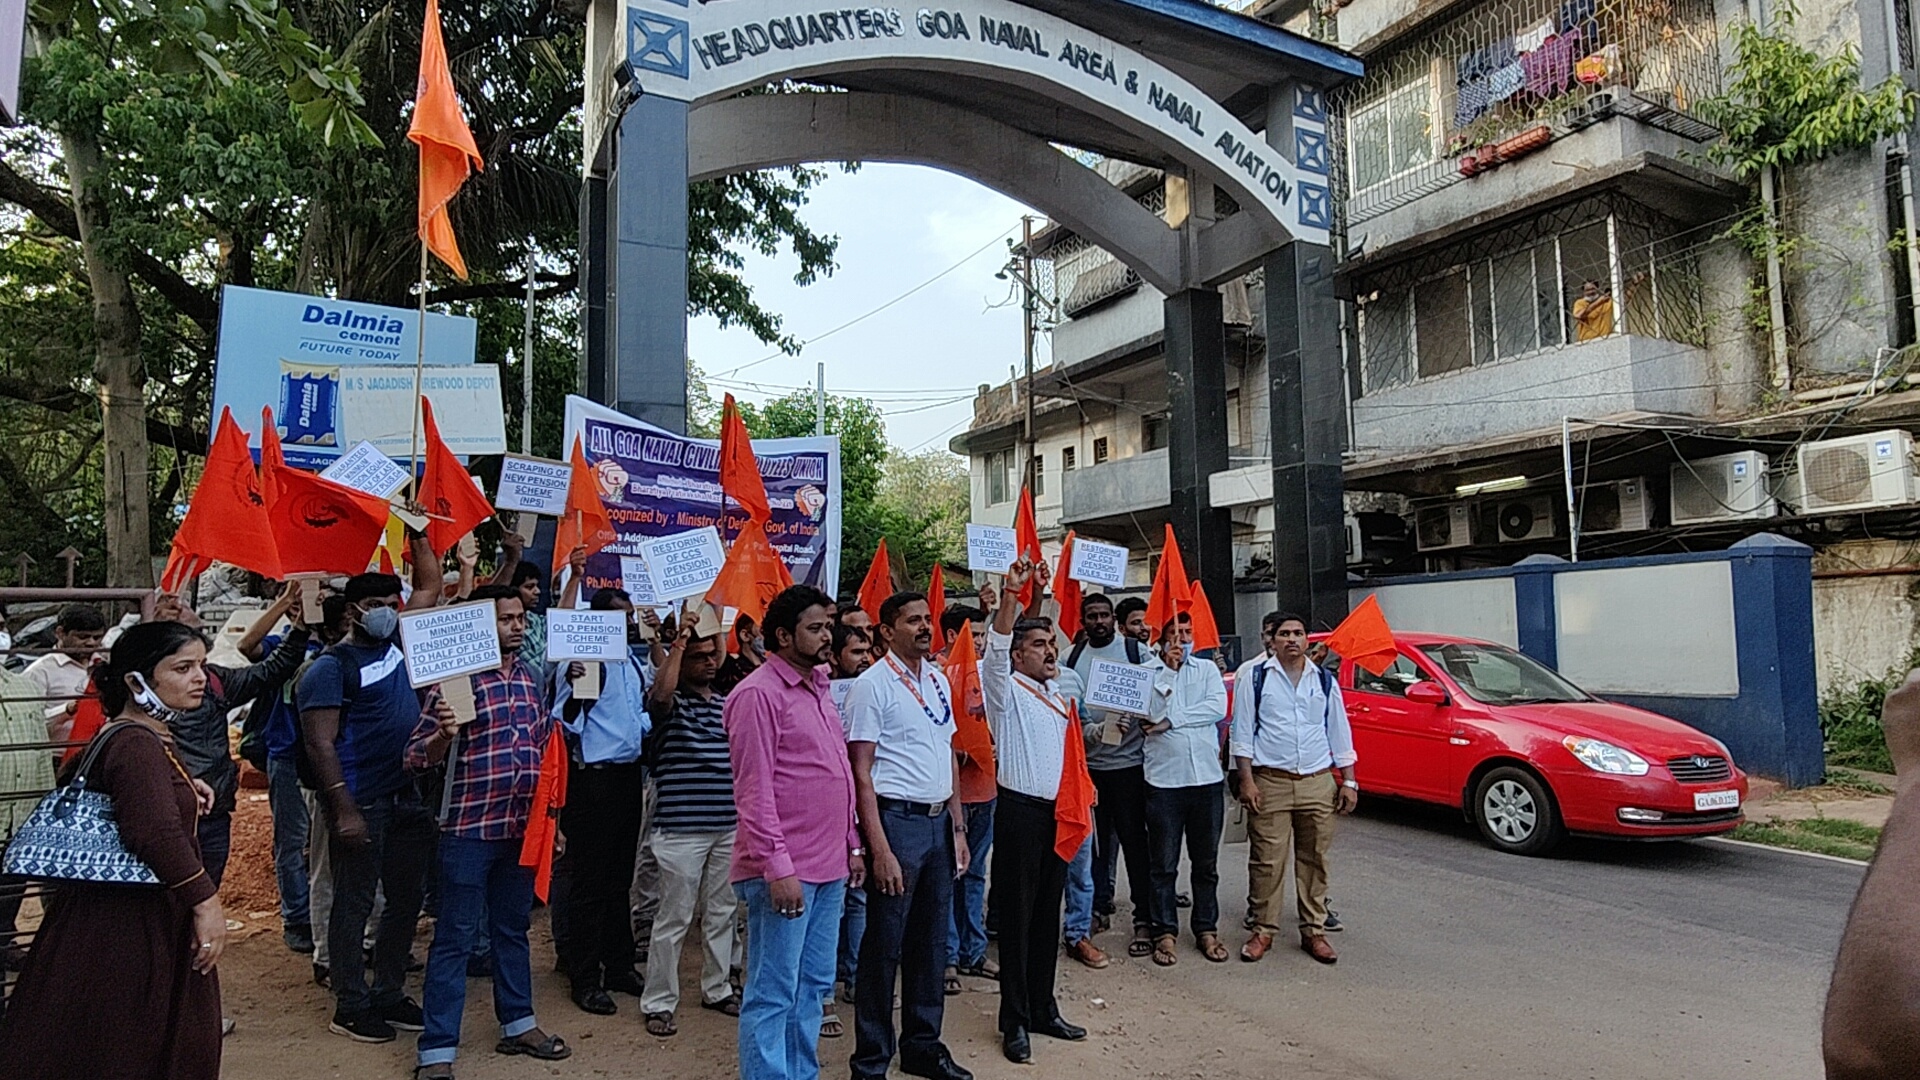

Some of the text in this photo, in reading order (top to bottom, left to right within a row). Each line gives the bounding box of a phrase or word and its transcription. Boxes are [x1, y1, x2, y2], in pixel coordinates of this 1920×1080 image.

[692, 7, 1293, 206] HEADQUARTERS GOA NAVAL AREA & NAVAL AVIATION
[302, 304, 404, 334] Dalmia
[338, 330, 401, 346] cement
[299, 341, 401, 361] FUTURE TODAY
[367, 376, 413, 391] JAGADISH
[419, 376, 463, 390] IREWOOD
[466, 376, 495, 390] DEPOT
[299, 382, 312, 428] Dalmia
[591, 425, 613, 455] ALL
[614, 430, 642, 460] GOA
[642, 436, 683, 466] NAVAL
[683, 443, 721, 472] CIVILI
[791, 456, 824, 480] UNION
[366, 457, 387, 475] EQUAL
[380, 462, 395, 478] LAST
[507, 461, 568, 478] SCRAPING OF
[379, 475, 394, 490] PLUS
[504, 473, 567, 489] NEW PENSION
[515, 485, 553, 498] SCHEME
[520, 496, 545, 508] (NPS)
[607, 508, 654, 525] cognized
[655, 511, 669, 528] by
[677, 512, 715, 528] Ministry
[789, 521, 800, 535] of
[800, 521, 820, 536] India
[983, 530, 1001, 539] STOP
[652, 535, 709, 556] RESTORING
[970, 538, 1014, 551] NEW PENSION
[1081, 543, 1121, 557] RESTORING
[666, 548, 702, 563] OF CCS
[979, 549, 1007, 558] SCHEME
[1098, 555, 1113, 564] CCS
[663, 557, 712, 578] (PENSION)
[700, 566, 720, 581] 1972
[1081, 560, 1117, 573] (PENSION)
[625, 573, 638, 581] NEW
[1104, 573, 1119, 582] 1972
[633, 583, 653, 592] SCHEM
[415, 608, 484, 630] GUARANTEED
[571, 614, 604, 622] START
[429, 622, 474, 638] MINIMUM
[553, 623, 622, 634] OLD PENSION
[413, 629, 492, 654] PENSION EQUAL
[566, 634, 609, 643] SCHEME
[412, 639, 496, 665] TO HALF OF LAST
[574, 644, 602, 654] (OPS)
[414, 660, 454, 677] SALARY
[456, 653, 482, 667] PLUS
[484, 650, 498, 661] DA
[1099, 663, 1148, 680] RESTORING
[1107, 675, 1137, 688] OF CCS
[1098, 683, 1141, 699] (PENSION)
[1126, 698, 1143, 709] 1972
